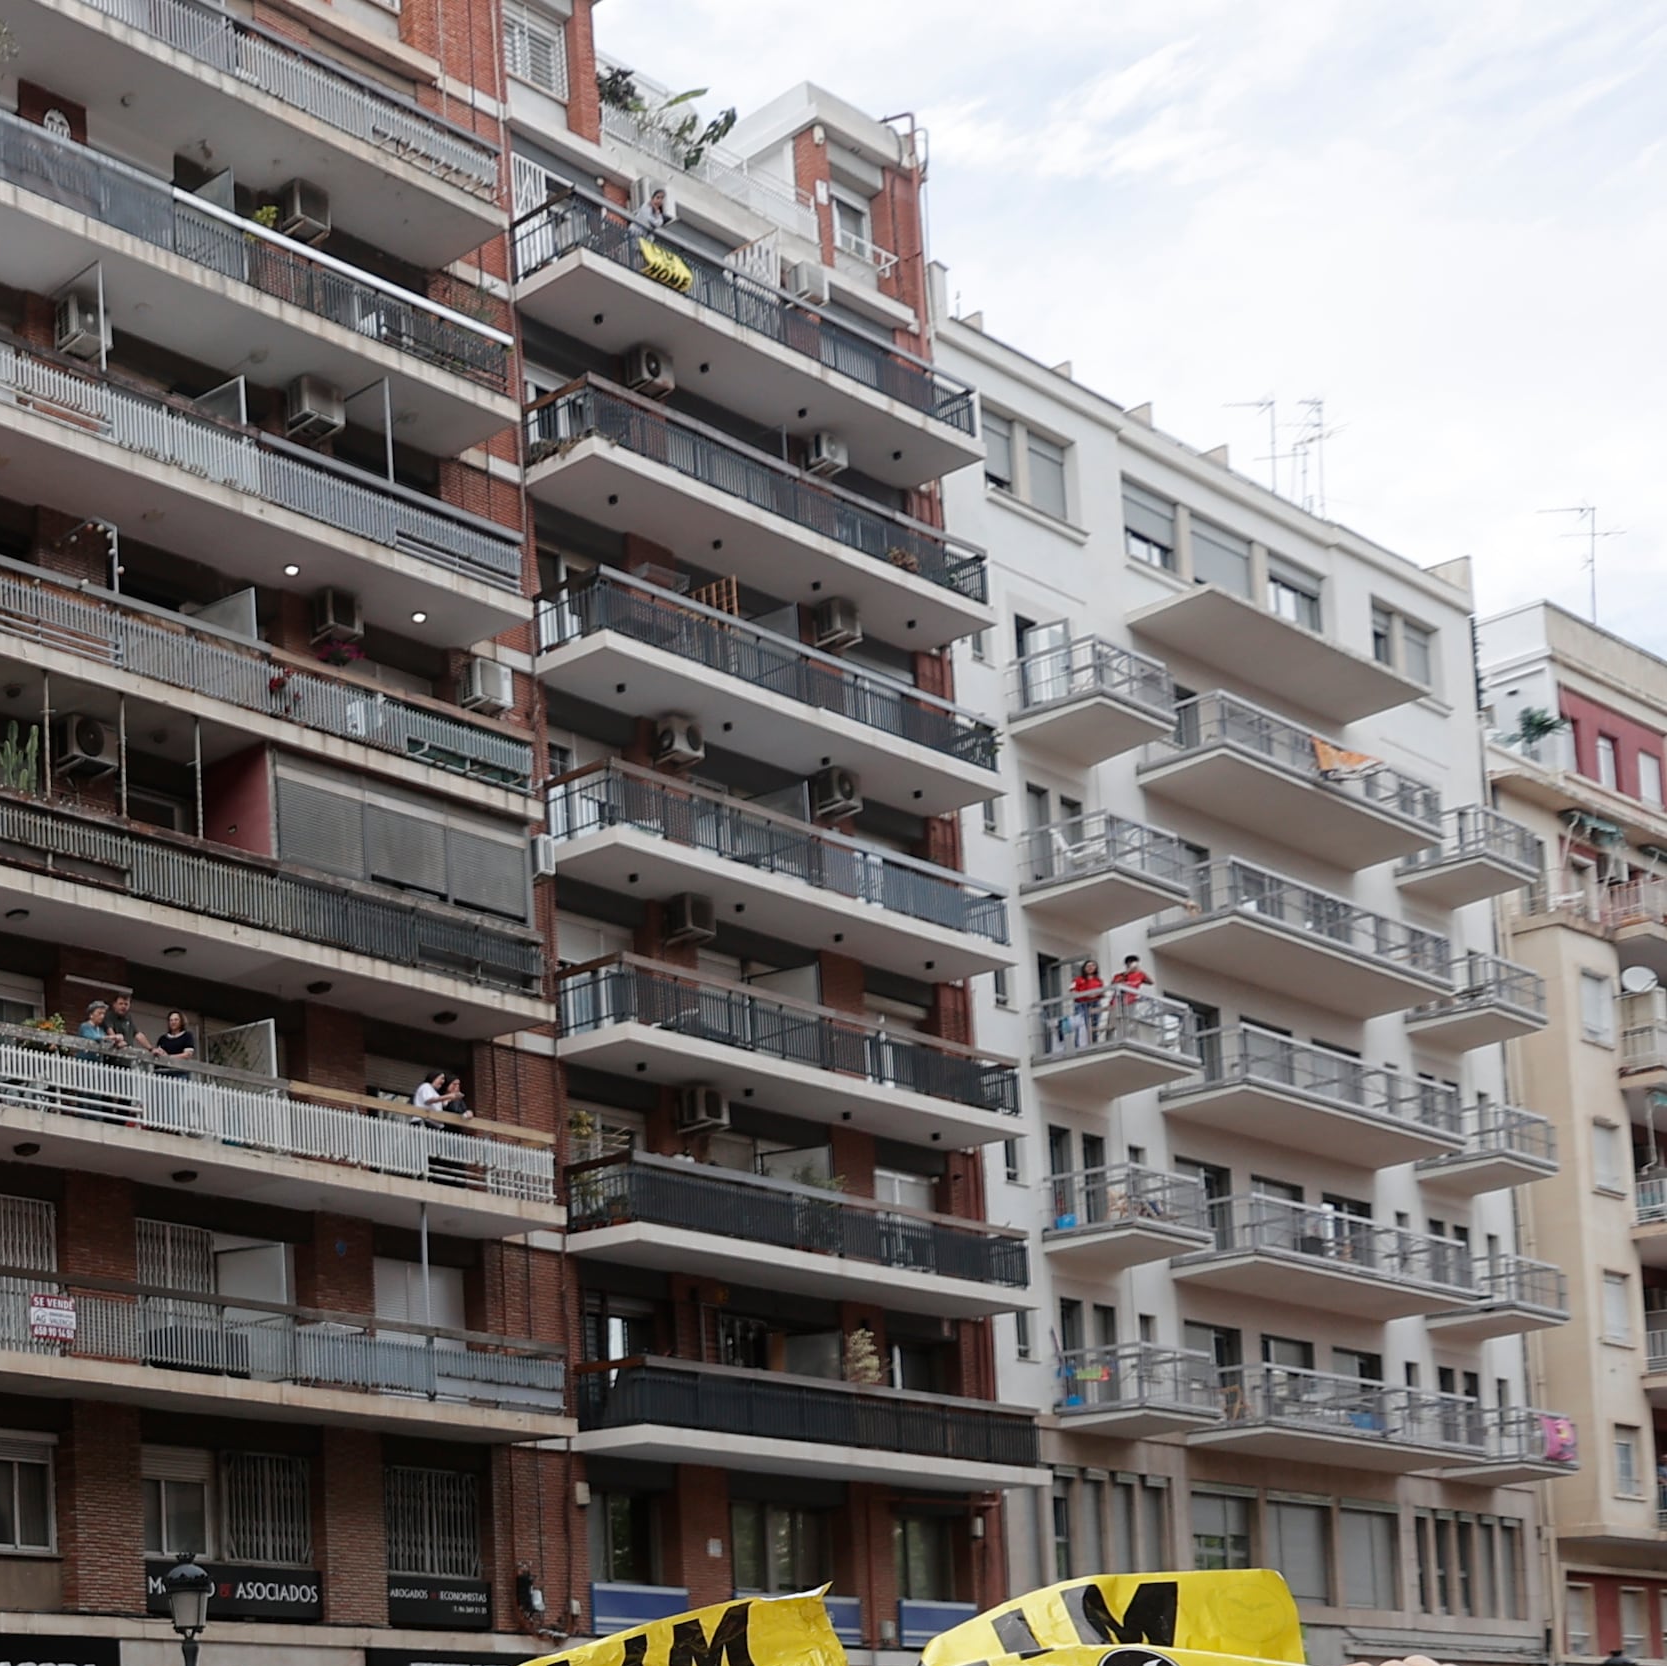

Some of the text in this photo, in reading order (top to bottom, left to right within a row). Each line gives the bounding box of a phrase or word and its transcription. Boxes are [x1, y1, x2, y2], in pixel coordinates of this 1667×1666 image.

[34, 1297, 73, 1310] SE VENDE
[236, 1583, 319, 1603] ASOCIADOS
[390, 1588, 487, 1602] ABOGADOS ECONOMISTAS
